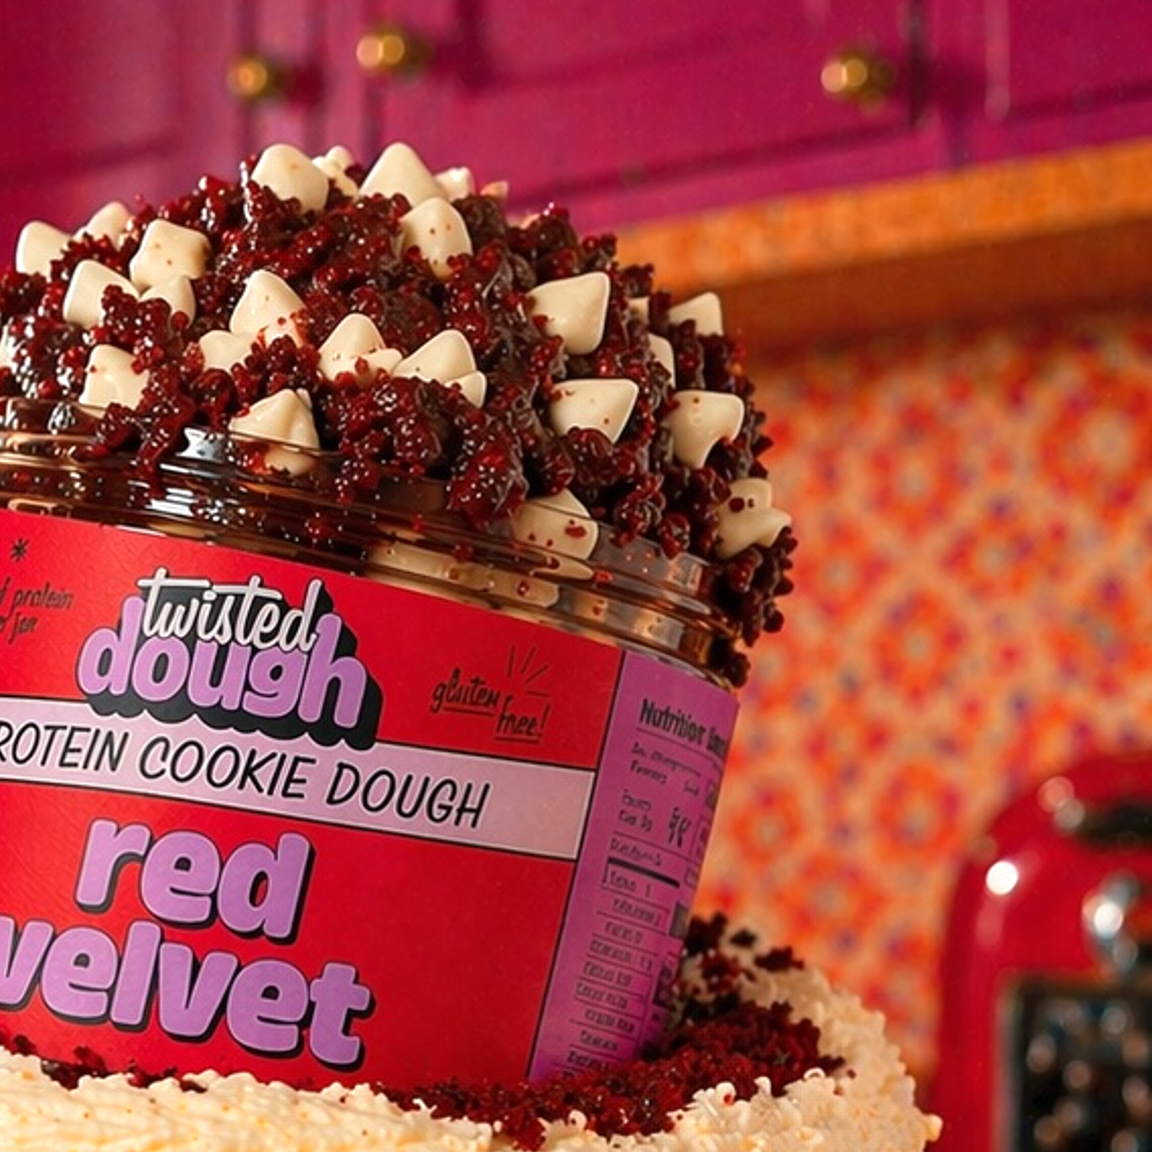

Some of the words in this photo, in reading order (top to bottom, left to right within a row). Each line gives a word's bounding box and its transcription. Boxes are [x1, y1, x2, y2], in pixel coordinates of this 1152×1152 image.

[6, 581, 74, 623] protein
[7, 611, 39, 645] jar
[137, 566, 323, 652] twisted
[76, 594, 368, 730] dough
[430, 666, 500, 715] gluten
[495, 694, 551, 738] free!
[138, 736, 317, 800] COOKIE
[326, 761, 491, 829] DOUGH
[74, 818, 313, 940] red
